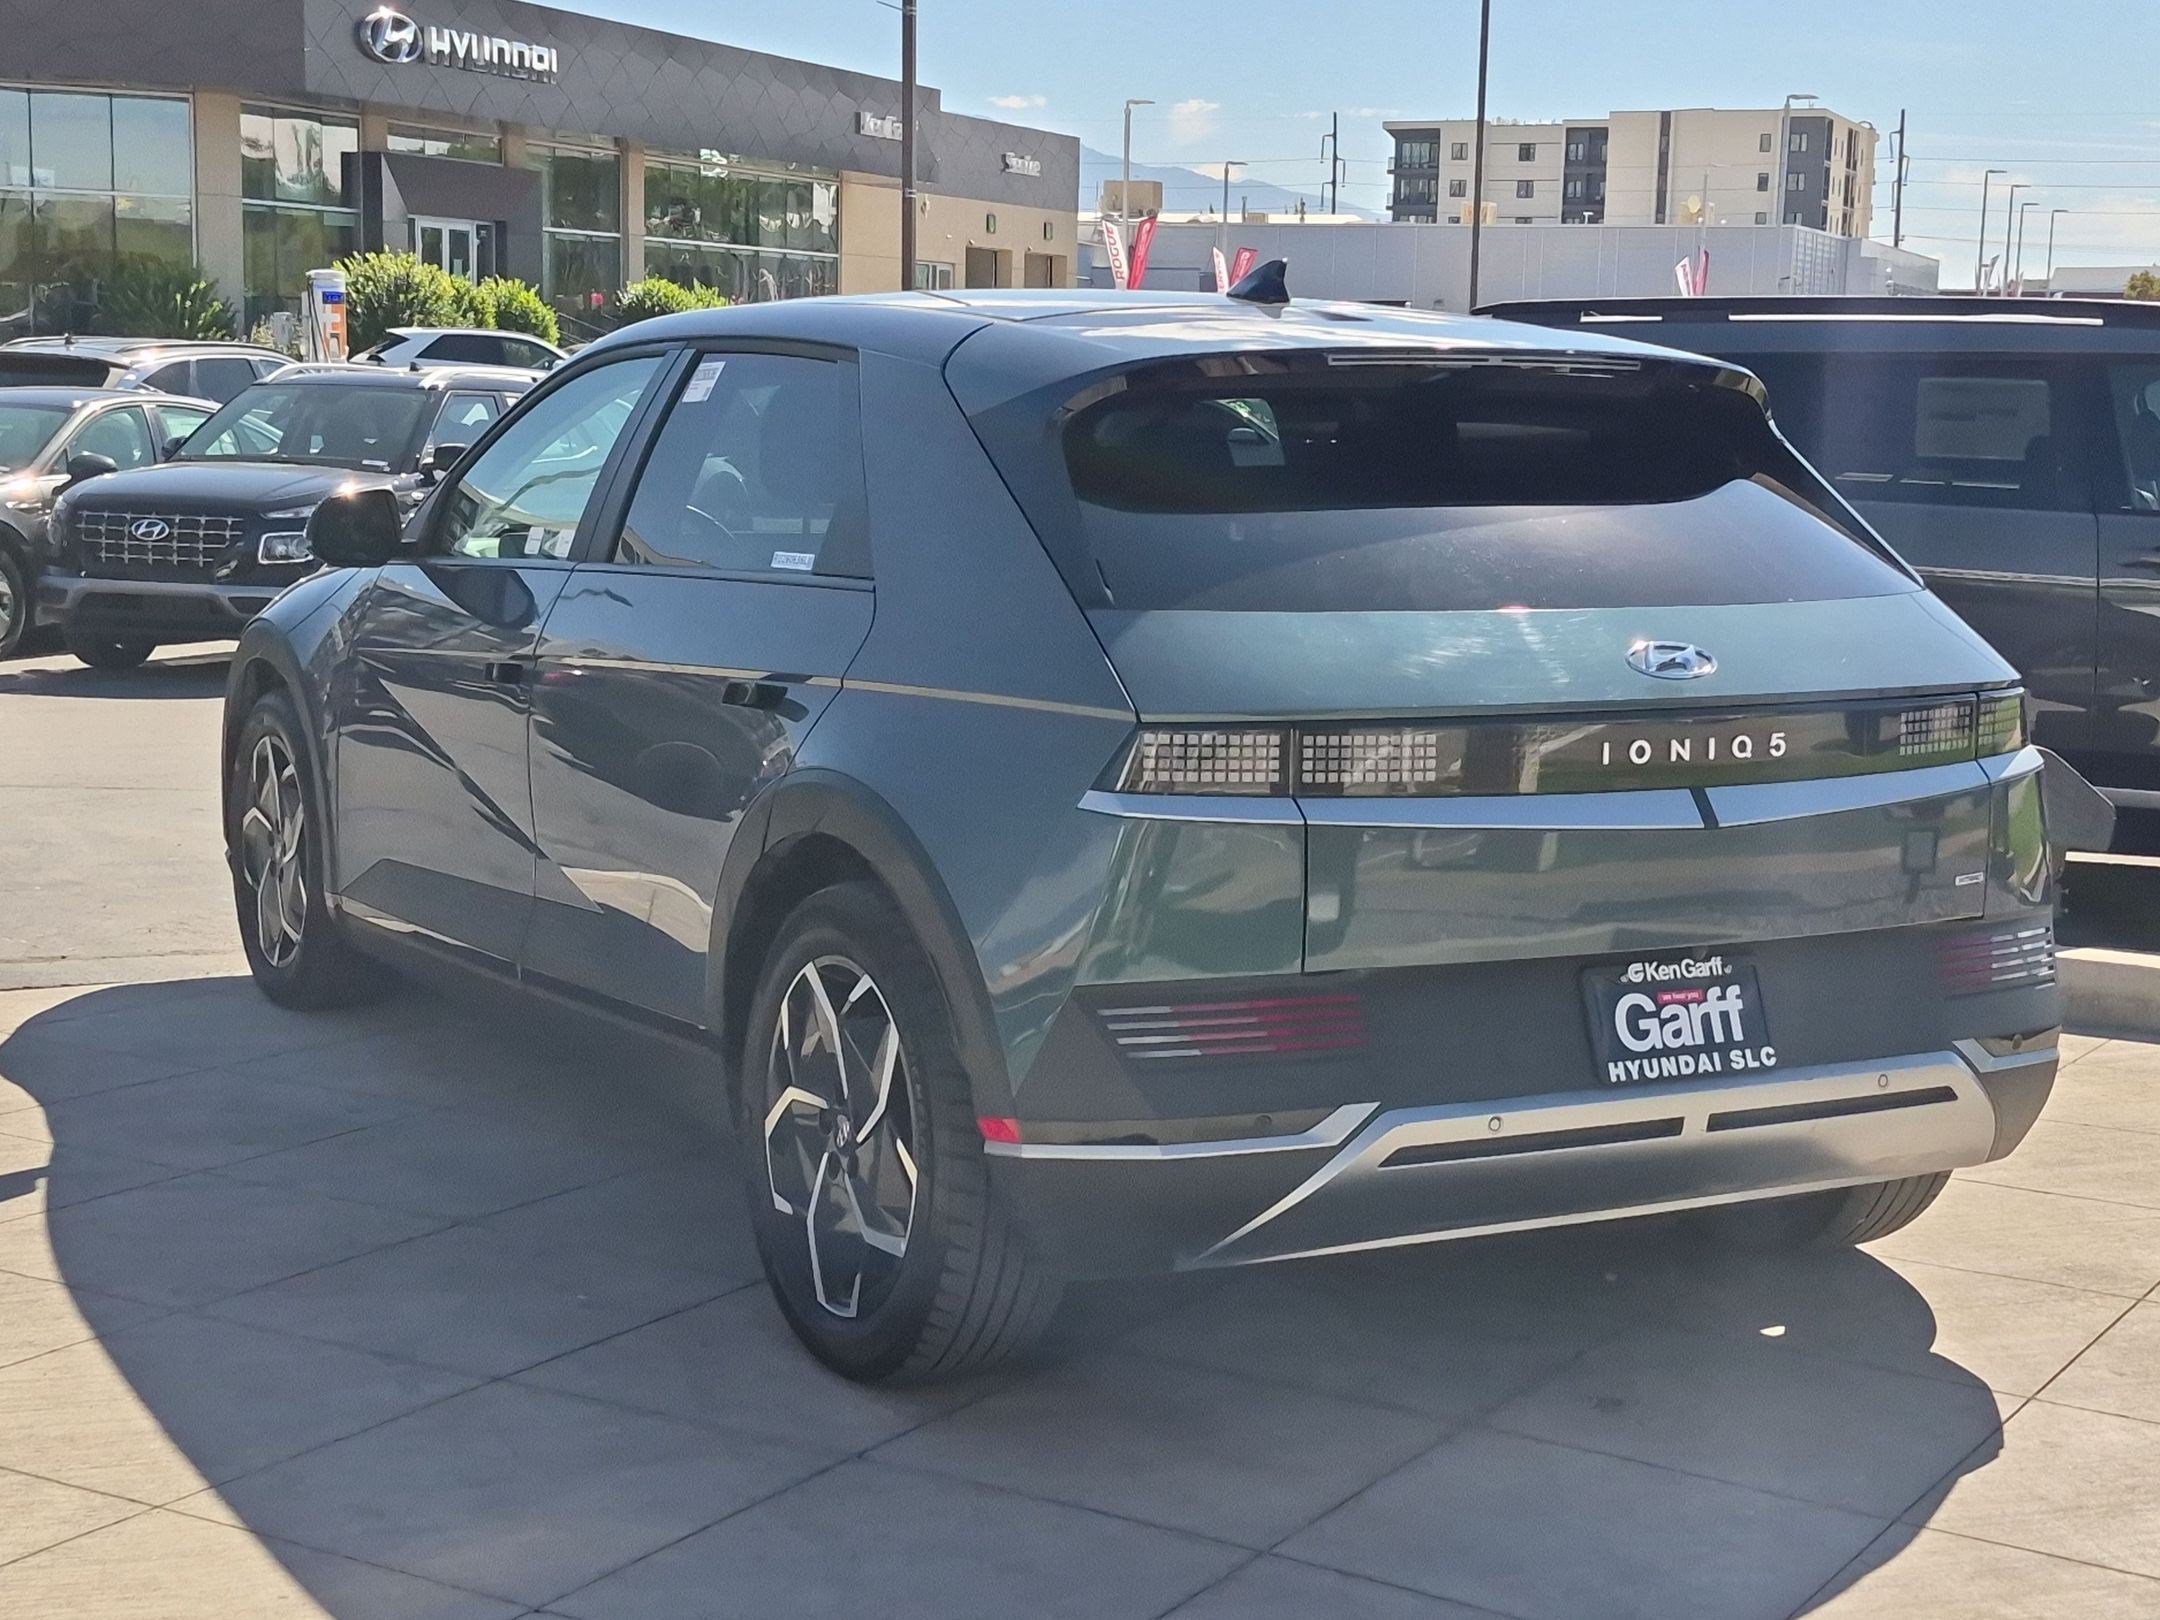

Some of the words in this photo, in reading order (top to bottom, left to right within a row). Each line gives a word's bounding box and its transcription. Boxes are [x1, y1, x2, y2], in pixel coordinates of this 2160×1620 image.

[429, 26, 558, 76] HYUNDAI
[1106, 224, 1125, 281] ROGUE
[1615, 984, 1744, 1053] Garff
[1608, 1052, 1722, 1083] HYUNDAI
[1730, 1046, 1778, 1070] SLC
